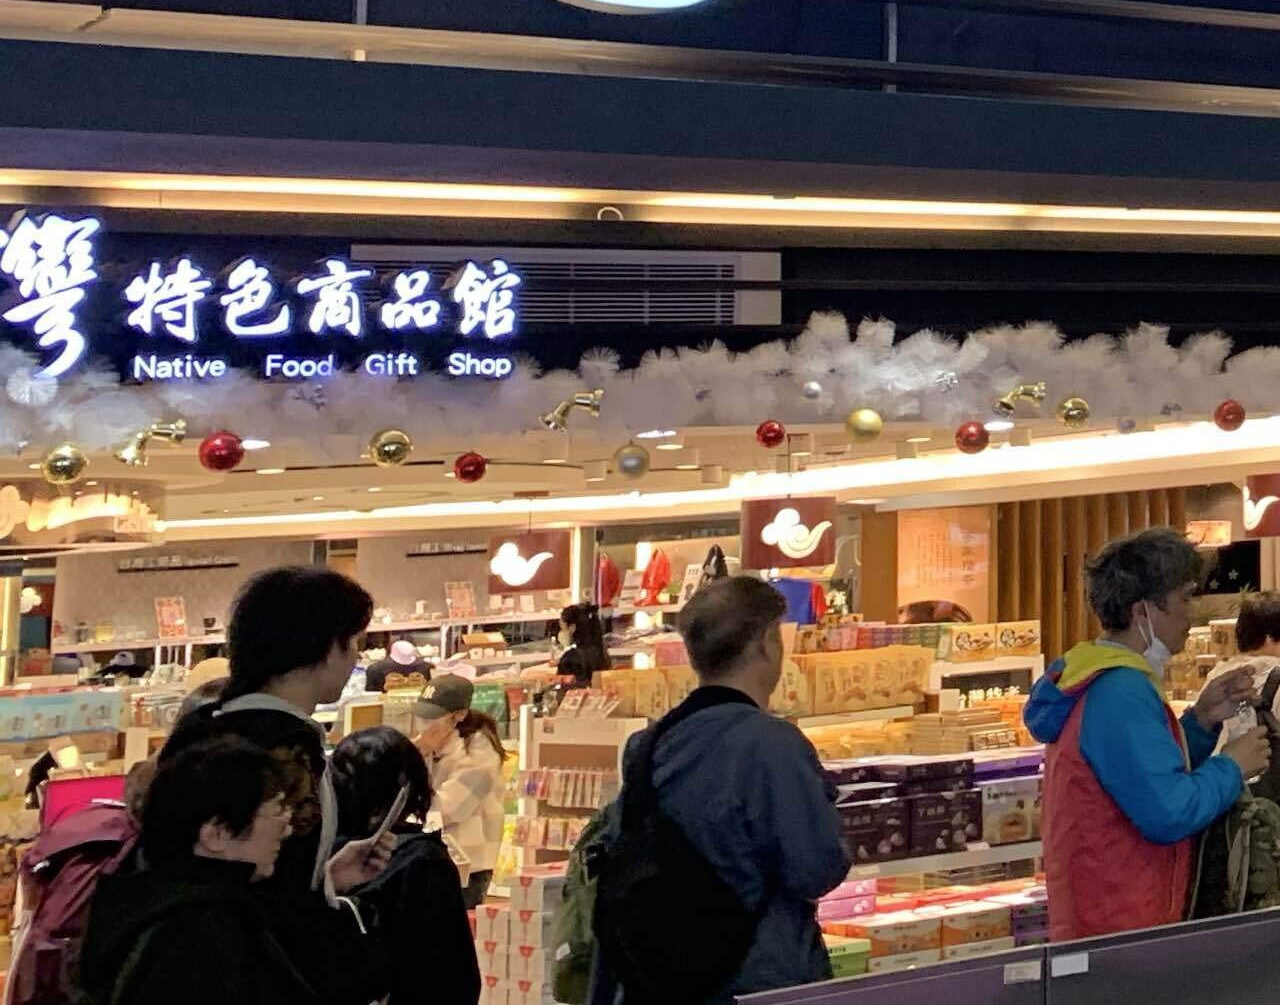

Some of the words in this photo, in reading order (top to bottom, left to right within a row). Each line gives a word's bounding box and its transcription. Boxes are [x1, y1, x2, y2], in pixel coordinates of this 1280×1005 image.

[124, 256, 522, 343] 特色商品館
[133, 353, 227, 381] Native
[265, 353, 335, 378] Food
[364, 352, 418, 377] Gift
[447, 351, 513, 379] Shop
